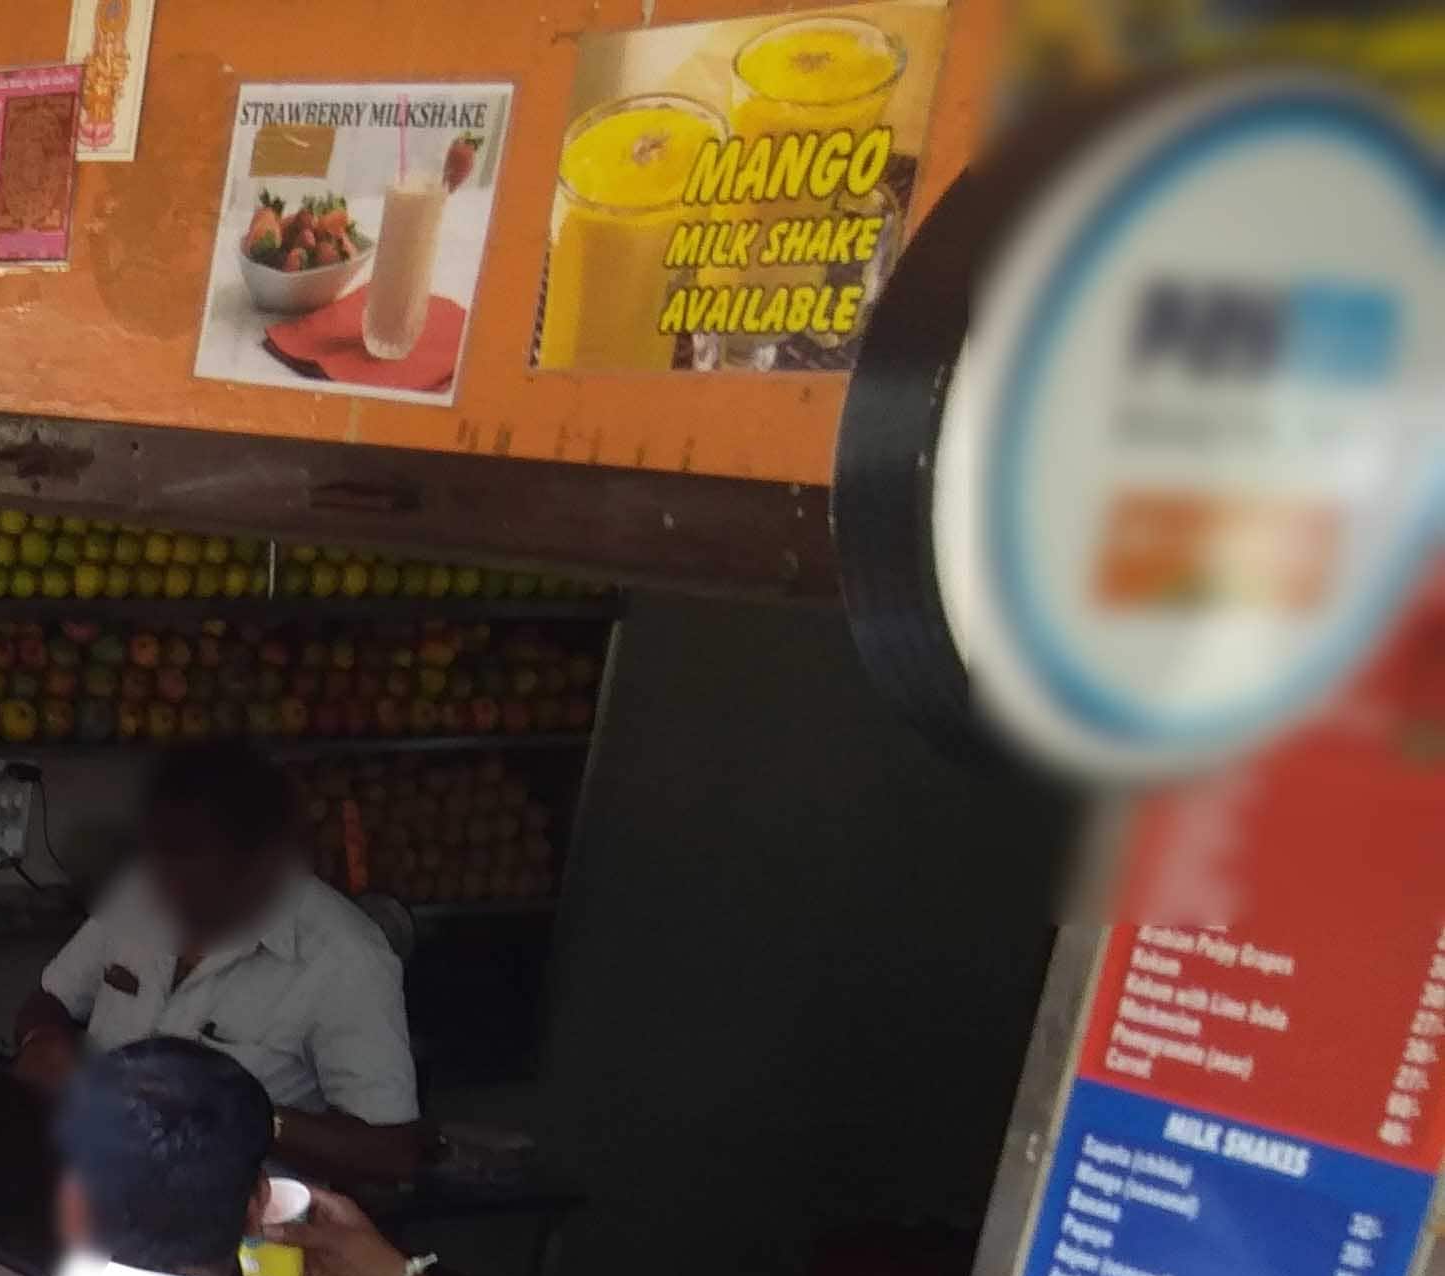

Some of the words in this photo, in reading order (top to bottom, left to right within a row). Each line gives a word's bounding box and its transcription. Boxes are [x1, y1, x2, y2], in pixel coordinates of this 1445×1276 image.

[240, 101, 363, 128] STRAWBERRY
[368, 101, 489, 128] MILKSHAKE
[682, 125, 892, 205] MANGO
[662, 219, 761, 269] MILK
[758, 216, 884, 266] SHAKE
[657, 284, 864, 336] AVAILABLE
[1162, 1111, 1222, 1153] MILK
[1221, 1127, 1311, 1178] SHAKES
